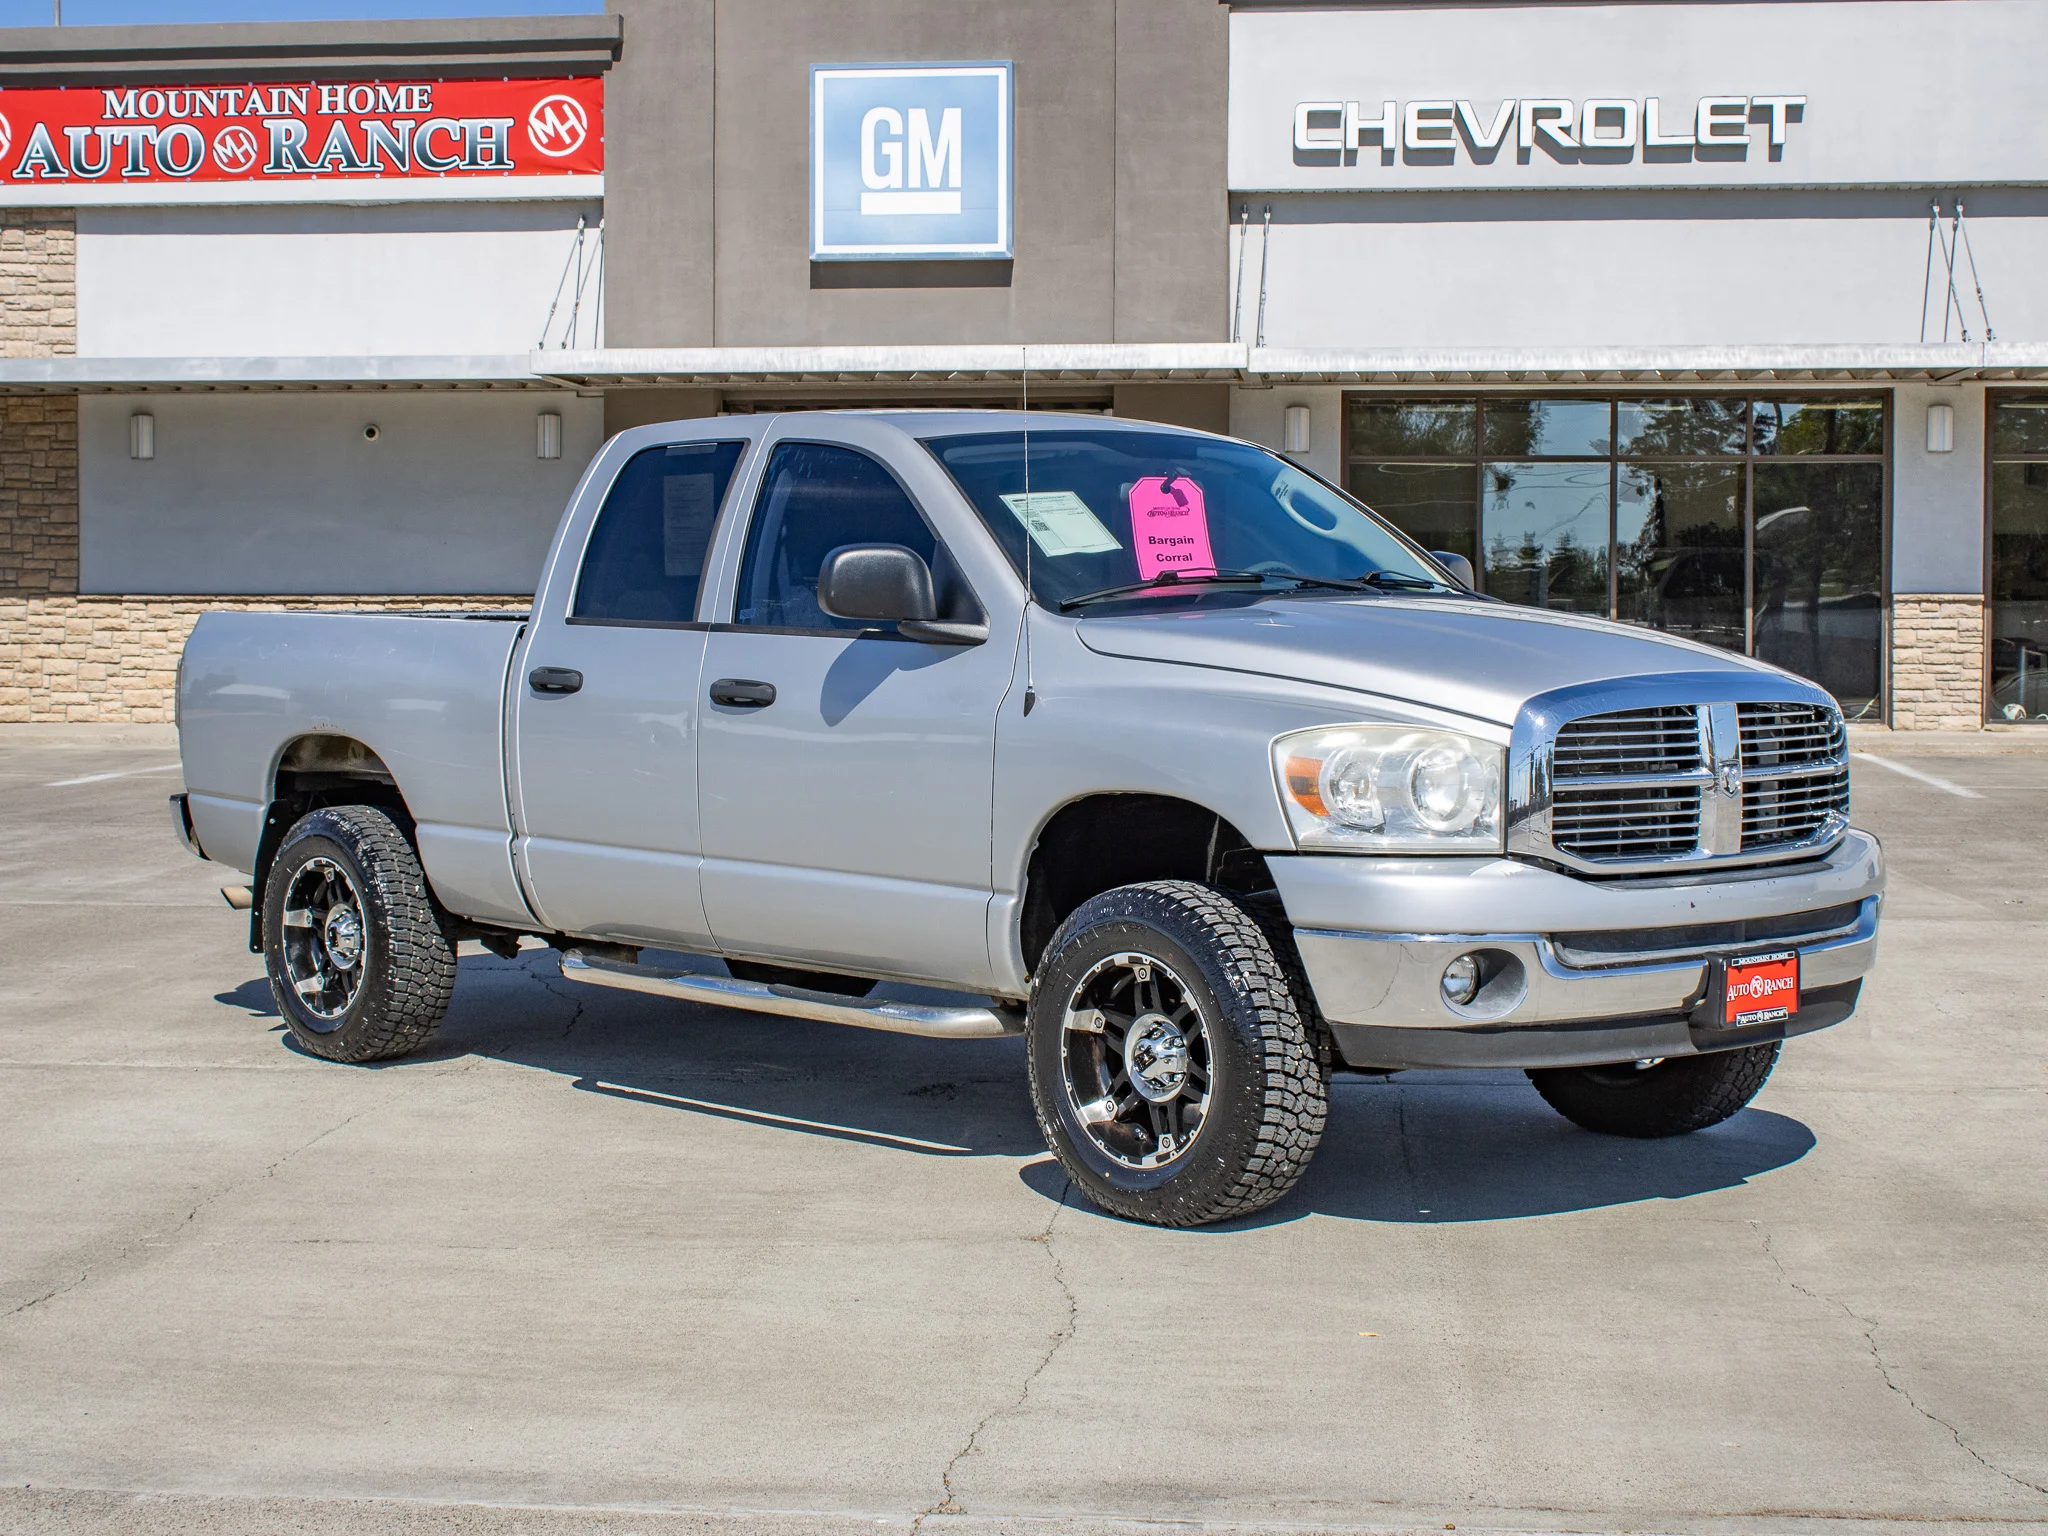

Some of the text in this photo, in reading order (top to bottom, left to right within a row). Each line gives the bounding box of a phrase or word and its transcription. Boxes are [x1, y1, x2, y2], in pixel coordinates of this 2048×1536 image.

[102, 84, 433, 120] MOUNTAIN HOME
[1293, 95, 1807, 151] CHEVROLET
[12, 121, 206, 179] AUTO
[262, 117, 515, 174] RANCH
[861, 107, 962, 189] GM
[1148, 535, 1195, 547] Bargain
[1156, 552, 1193, 562] Corral
[1727, 985, 1750, 1001] AUTO
[1764, 977, 1794, 995] RANCH
[1740, 1014, 1757, 1023] AUTO
[1764, 1010, 1784, 1020] RANCH
